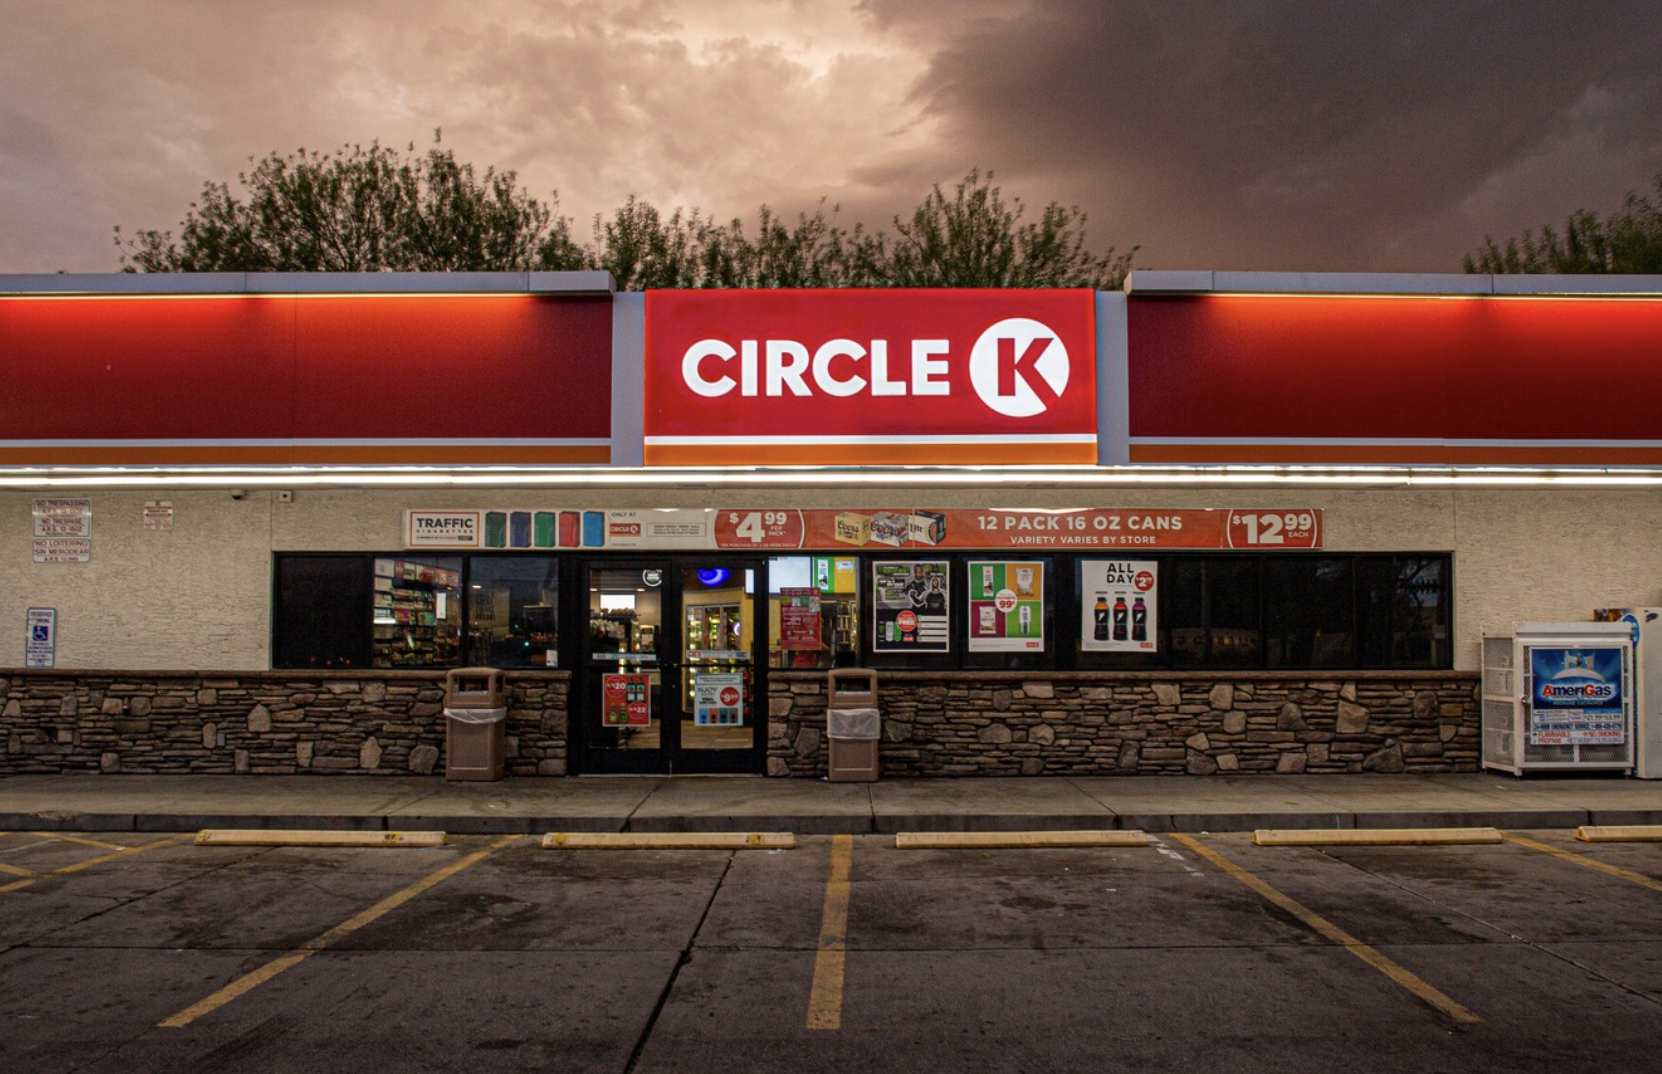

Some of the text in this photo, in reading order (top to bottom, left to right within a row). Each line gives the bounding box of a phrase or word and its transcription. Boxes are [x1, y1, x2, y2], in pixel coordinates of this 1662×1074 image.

[682, 339, 950, 397] CIRCLE
[416, 518, 474, 528] TRAFFIC
[978, 516, 1183, 530] 12 PACK 16 OZ CANS
[1010, 536, 1156, 544] VARIETY VARIES BY STORE
[1107, 563, 1135, 573] ALL
[1107, 574, 1135, 583] DAY
[1542, 684, 1612, 697] AmeriGas
